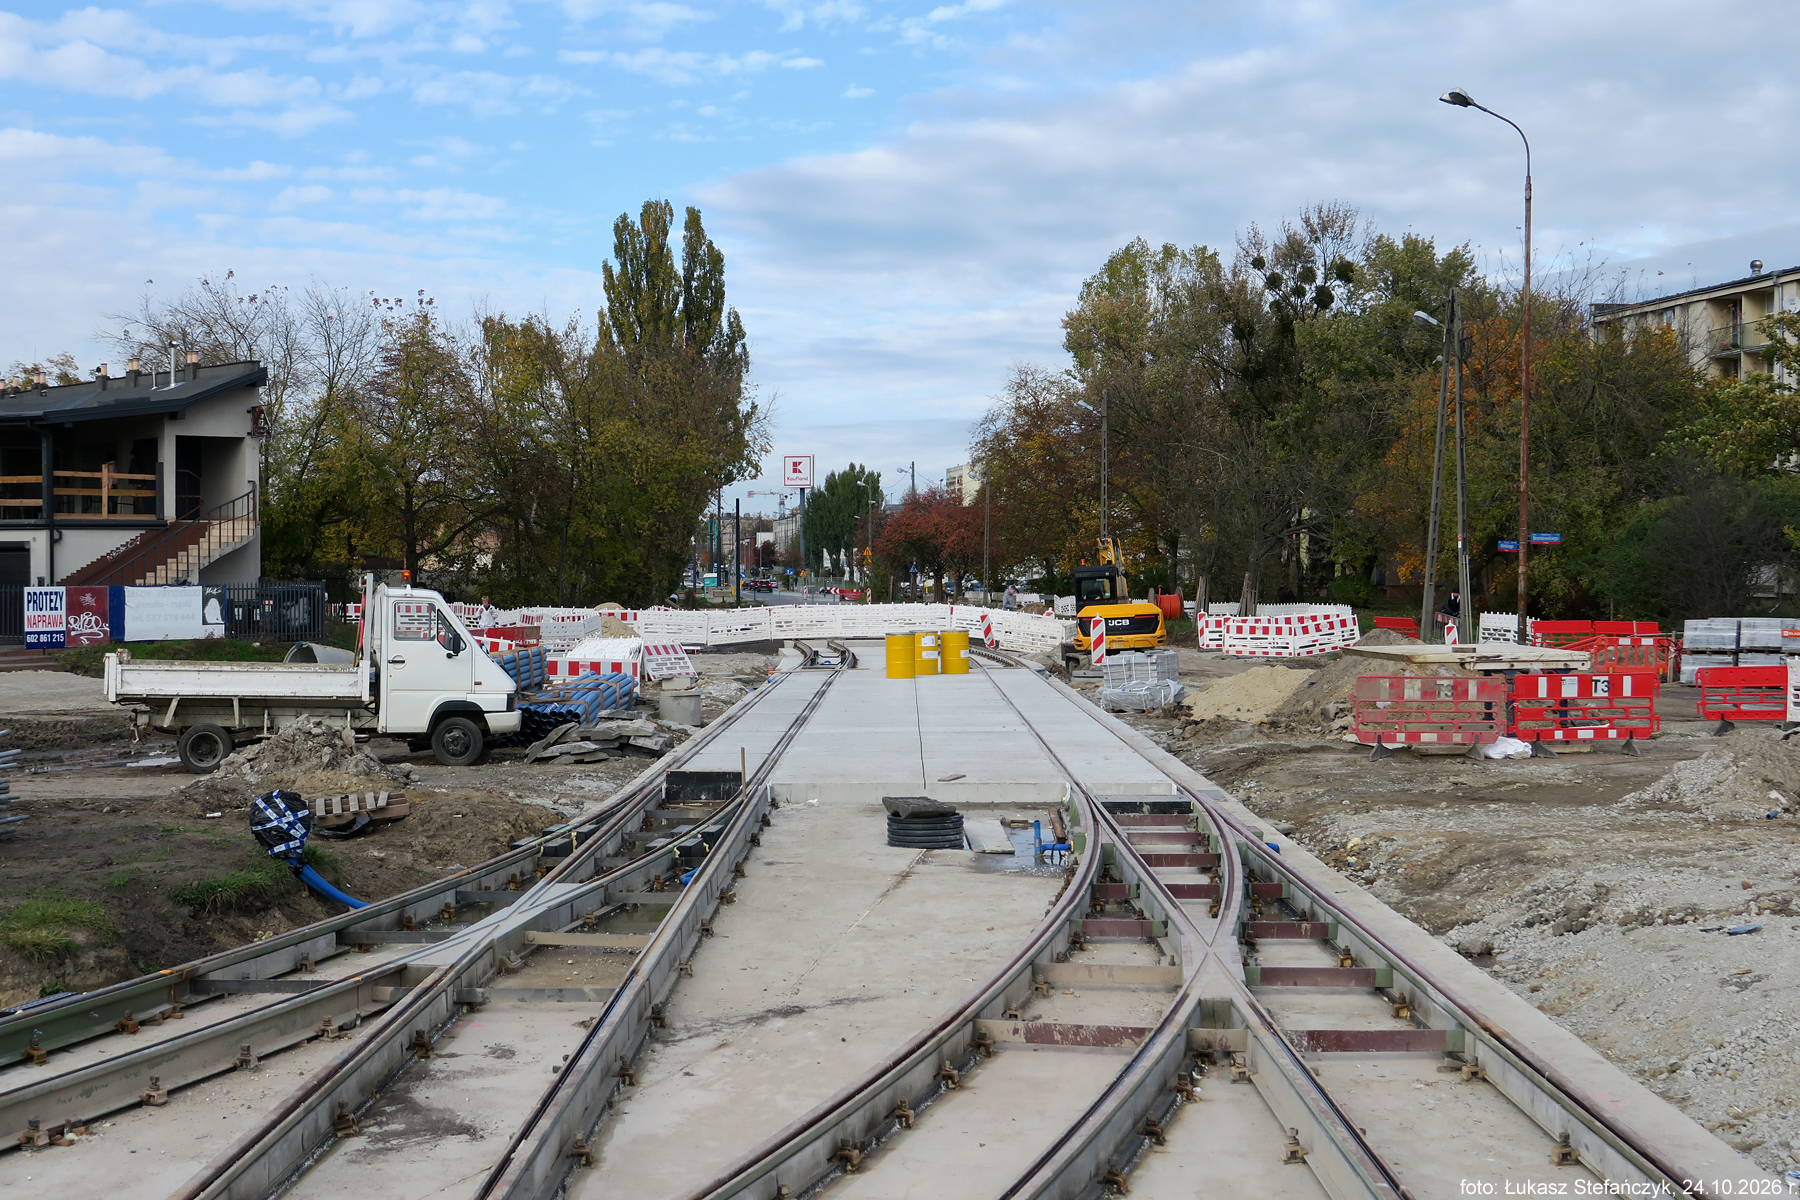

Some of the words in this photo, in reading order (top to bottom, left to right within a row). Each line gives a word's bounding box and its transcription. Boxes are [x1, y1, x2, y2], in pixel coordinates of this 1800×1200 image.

[26, 591, 64, 612] PROTEZY
[26, 614, 64, 629] NAPRAWA
[26, 634, 39, 643] 602
[39, 633, 51, 643] 861
[52, 633, 65, 642] 215
[1434, 683, 1454, 698] T3
[1591, 678, 1611, 693] T3
